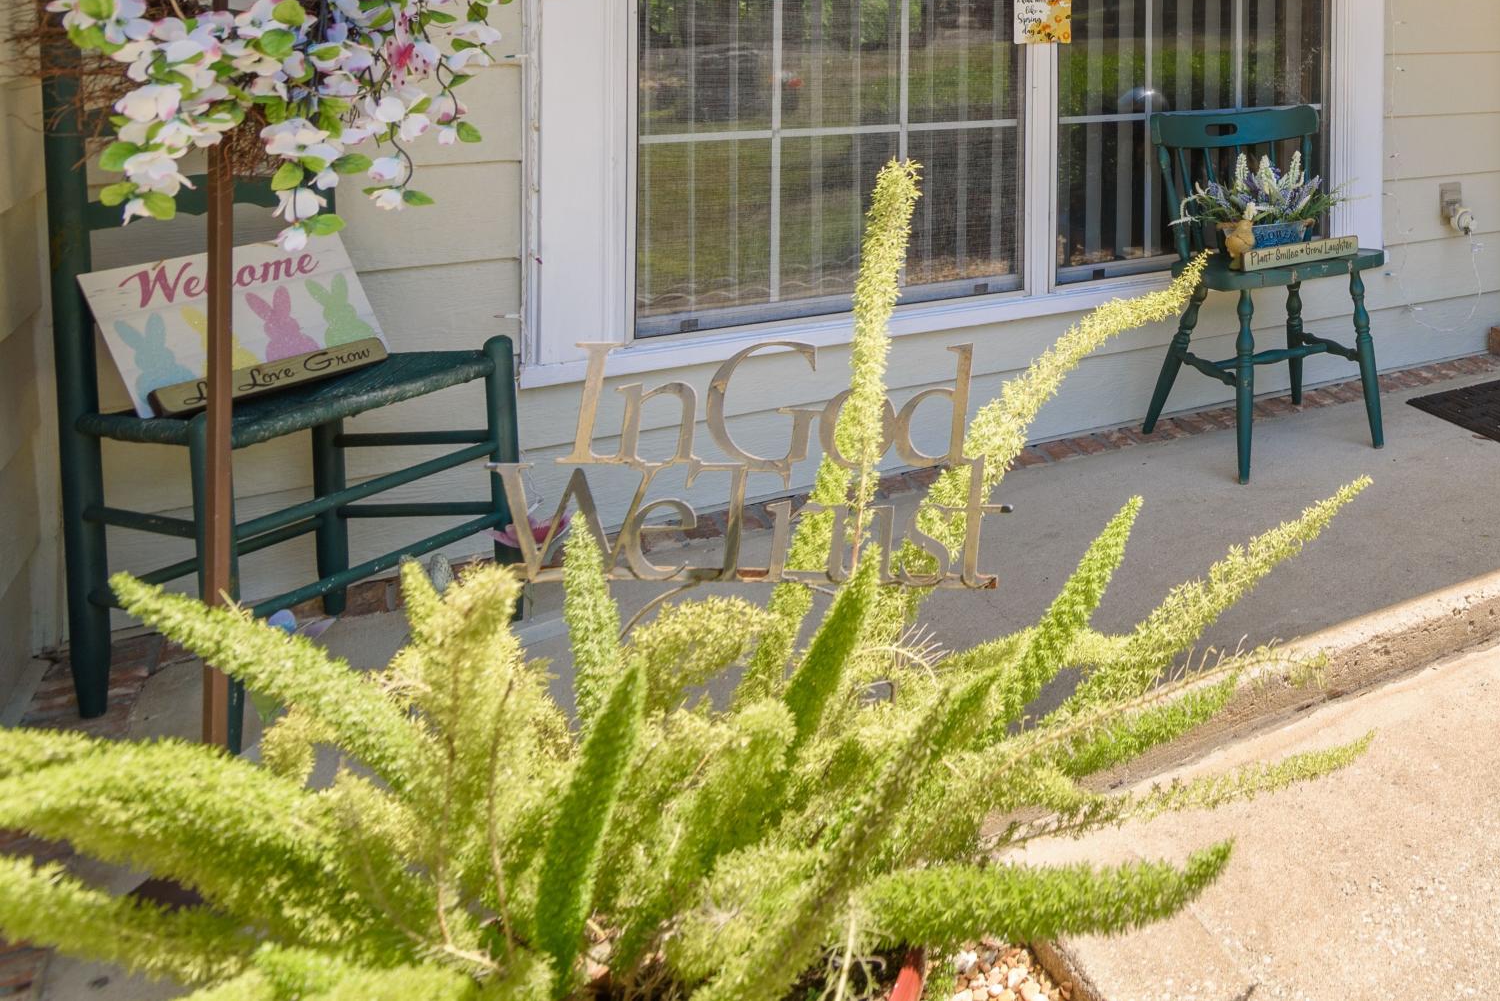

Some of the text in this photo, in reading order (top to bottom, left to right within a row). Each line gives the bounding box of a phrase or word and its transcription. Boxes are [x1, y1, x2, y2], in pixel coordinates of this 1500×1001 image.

[1017, 12, 1042, 28] Spring
[1022, 25, 1035, 36] day
[1250, 238, 1353, 266] Plant Smiles Grow Laughter
[118, 252, 320, 309] Weome
[238, 347, 371, 392] Love Grow
